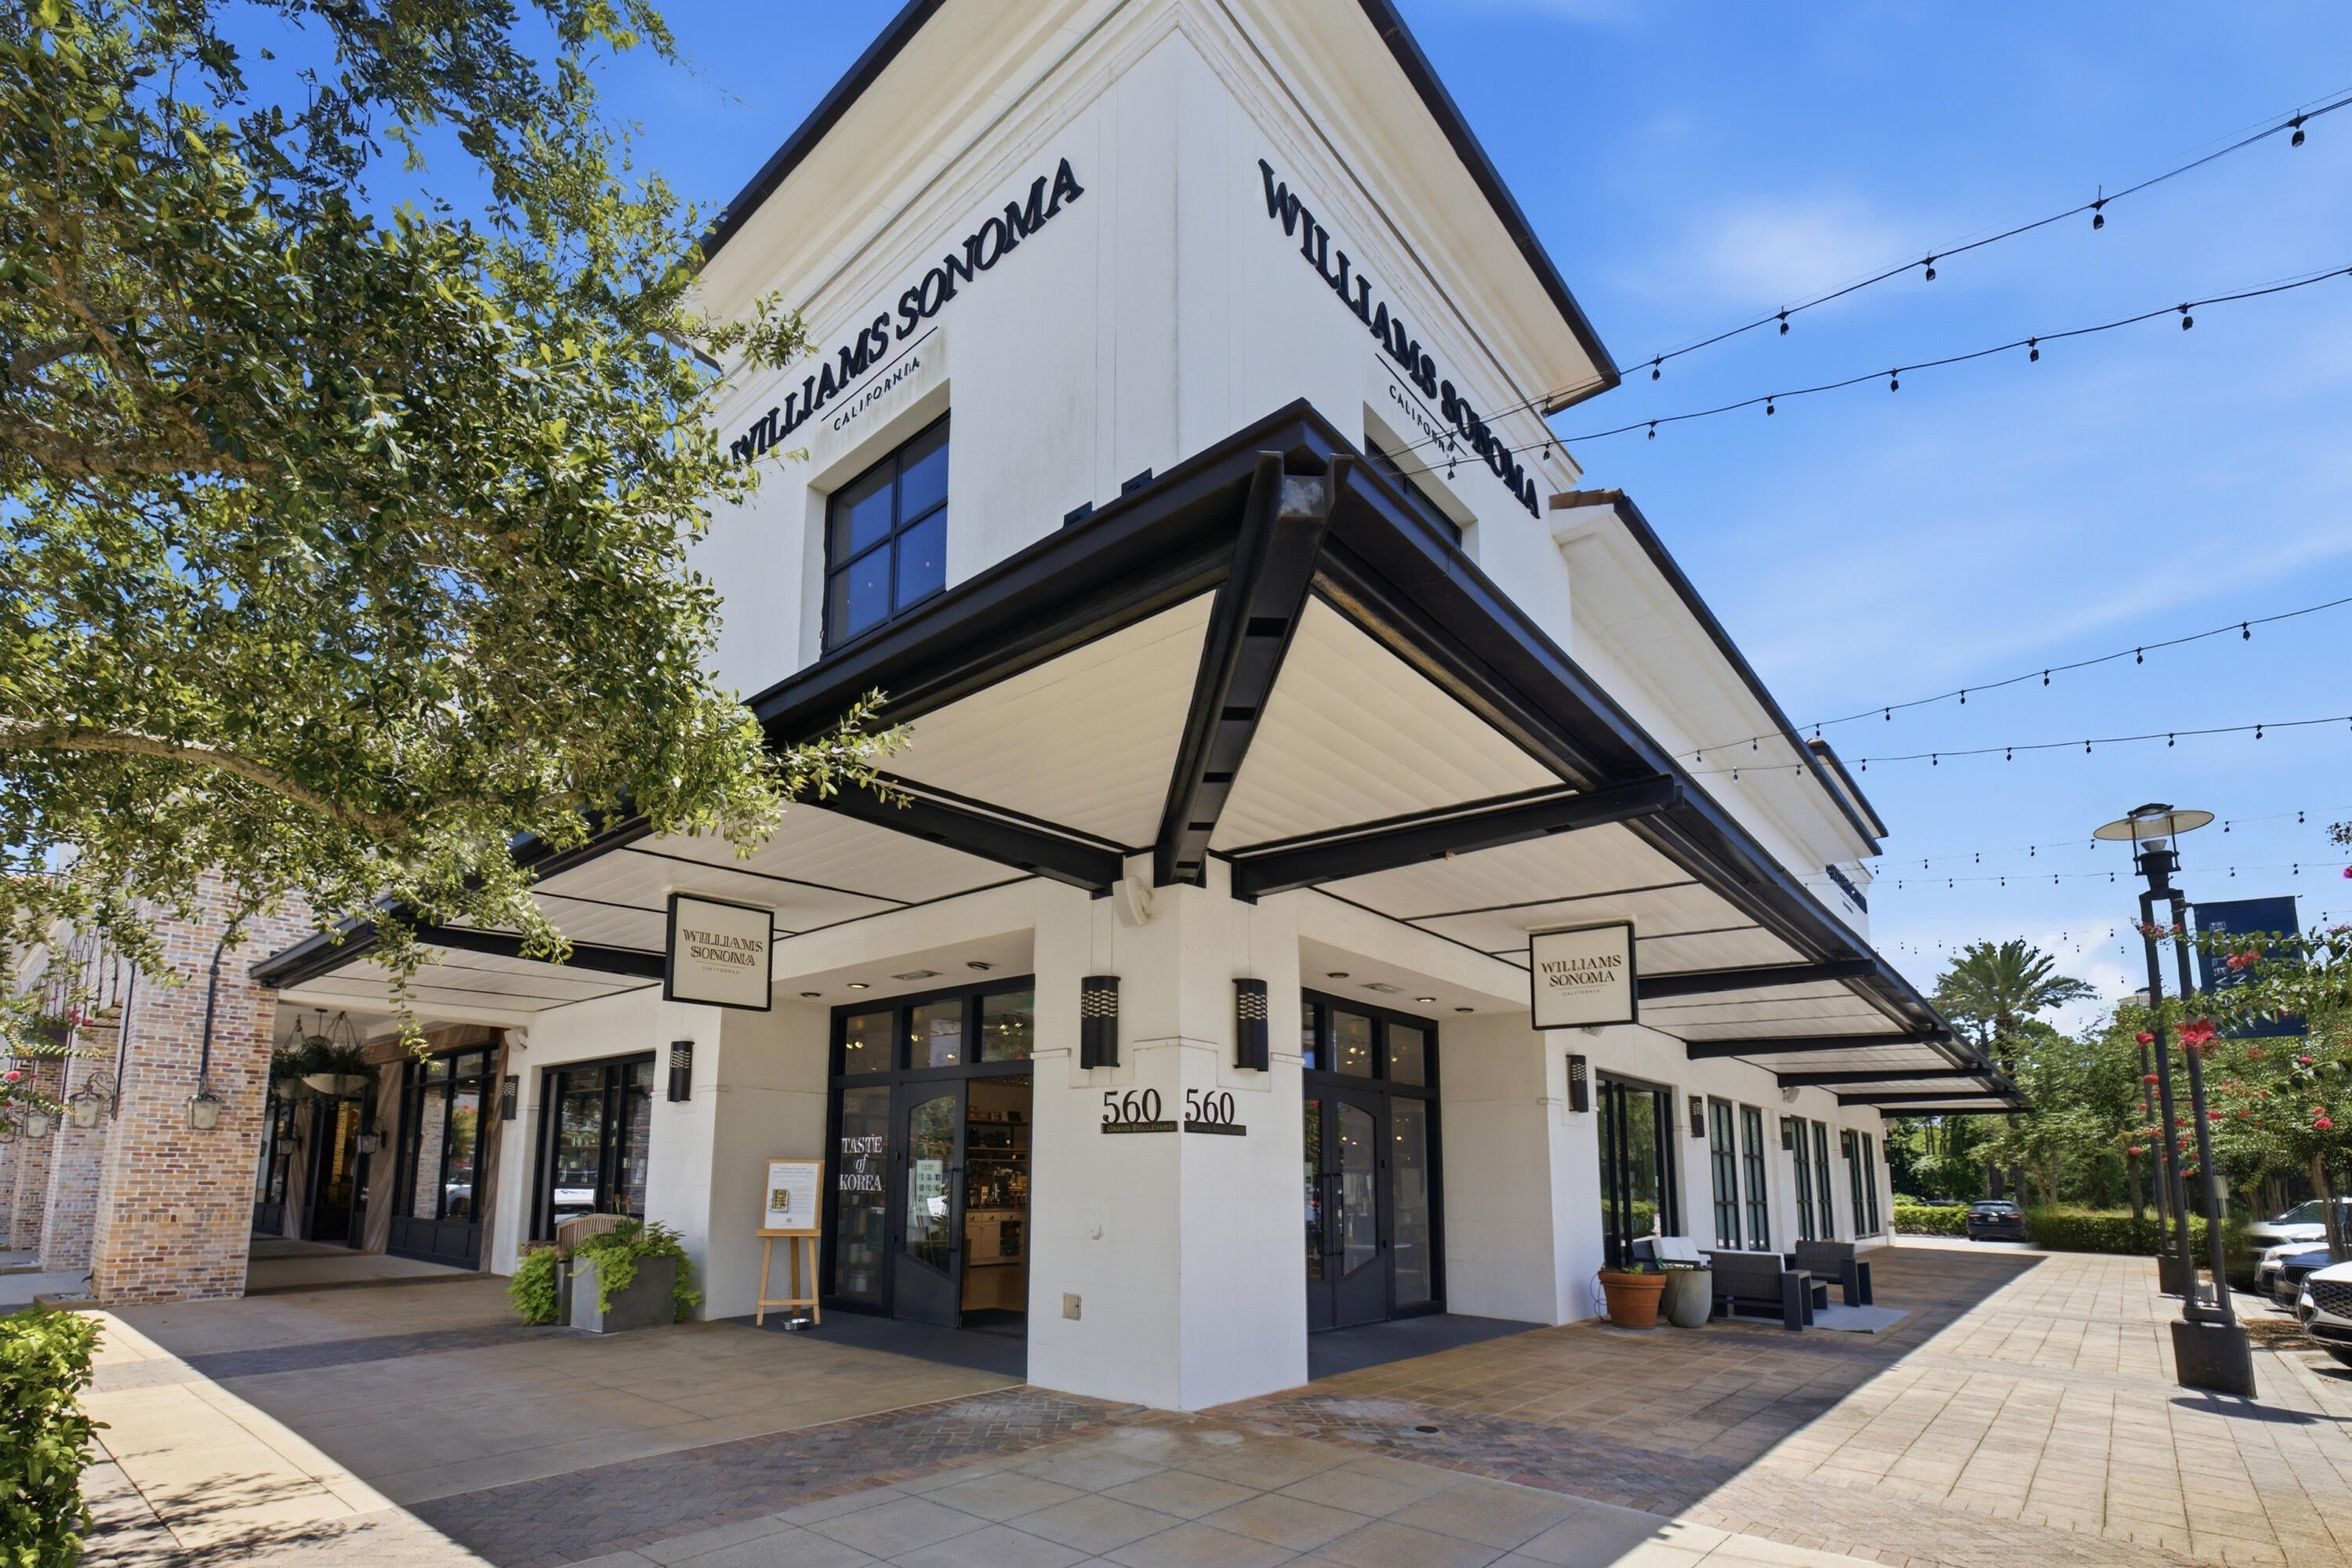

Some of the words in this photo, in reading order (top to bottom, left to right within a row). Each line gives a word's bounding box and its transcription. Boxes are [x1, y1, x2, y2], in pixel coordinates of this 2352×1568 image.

[730, 311, 890, 468] WILLIAMS
[896, 157, 1085, 341] SONOMA
[1258, 158, 1437, 399] WILLIAMS
[1441, 379, 1541, 519] SONOMA
[833, 356, 921, 431] CALIFORNIA
[684, 929, 764, 953] WILLIAMS
[691, 946, 756, 966] SONOMA
[1541, 955, 1621, 974] WILLIAMS
[1550, 971, 1615, 987] SONOMA
[1102, 1088, 1162, 1124] 560
[1185, 1088, 1235, 1123] 560
[841, 1136, 883, 1154] TASTE
[855, 1154, 869, 1173] of
[840, 1174, 881, 1192] KOREA
